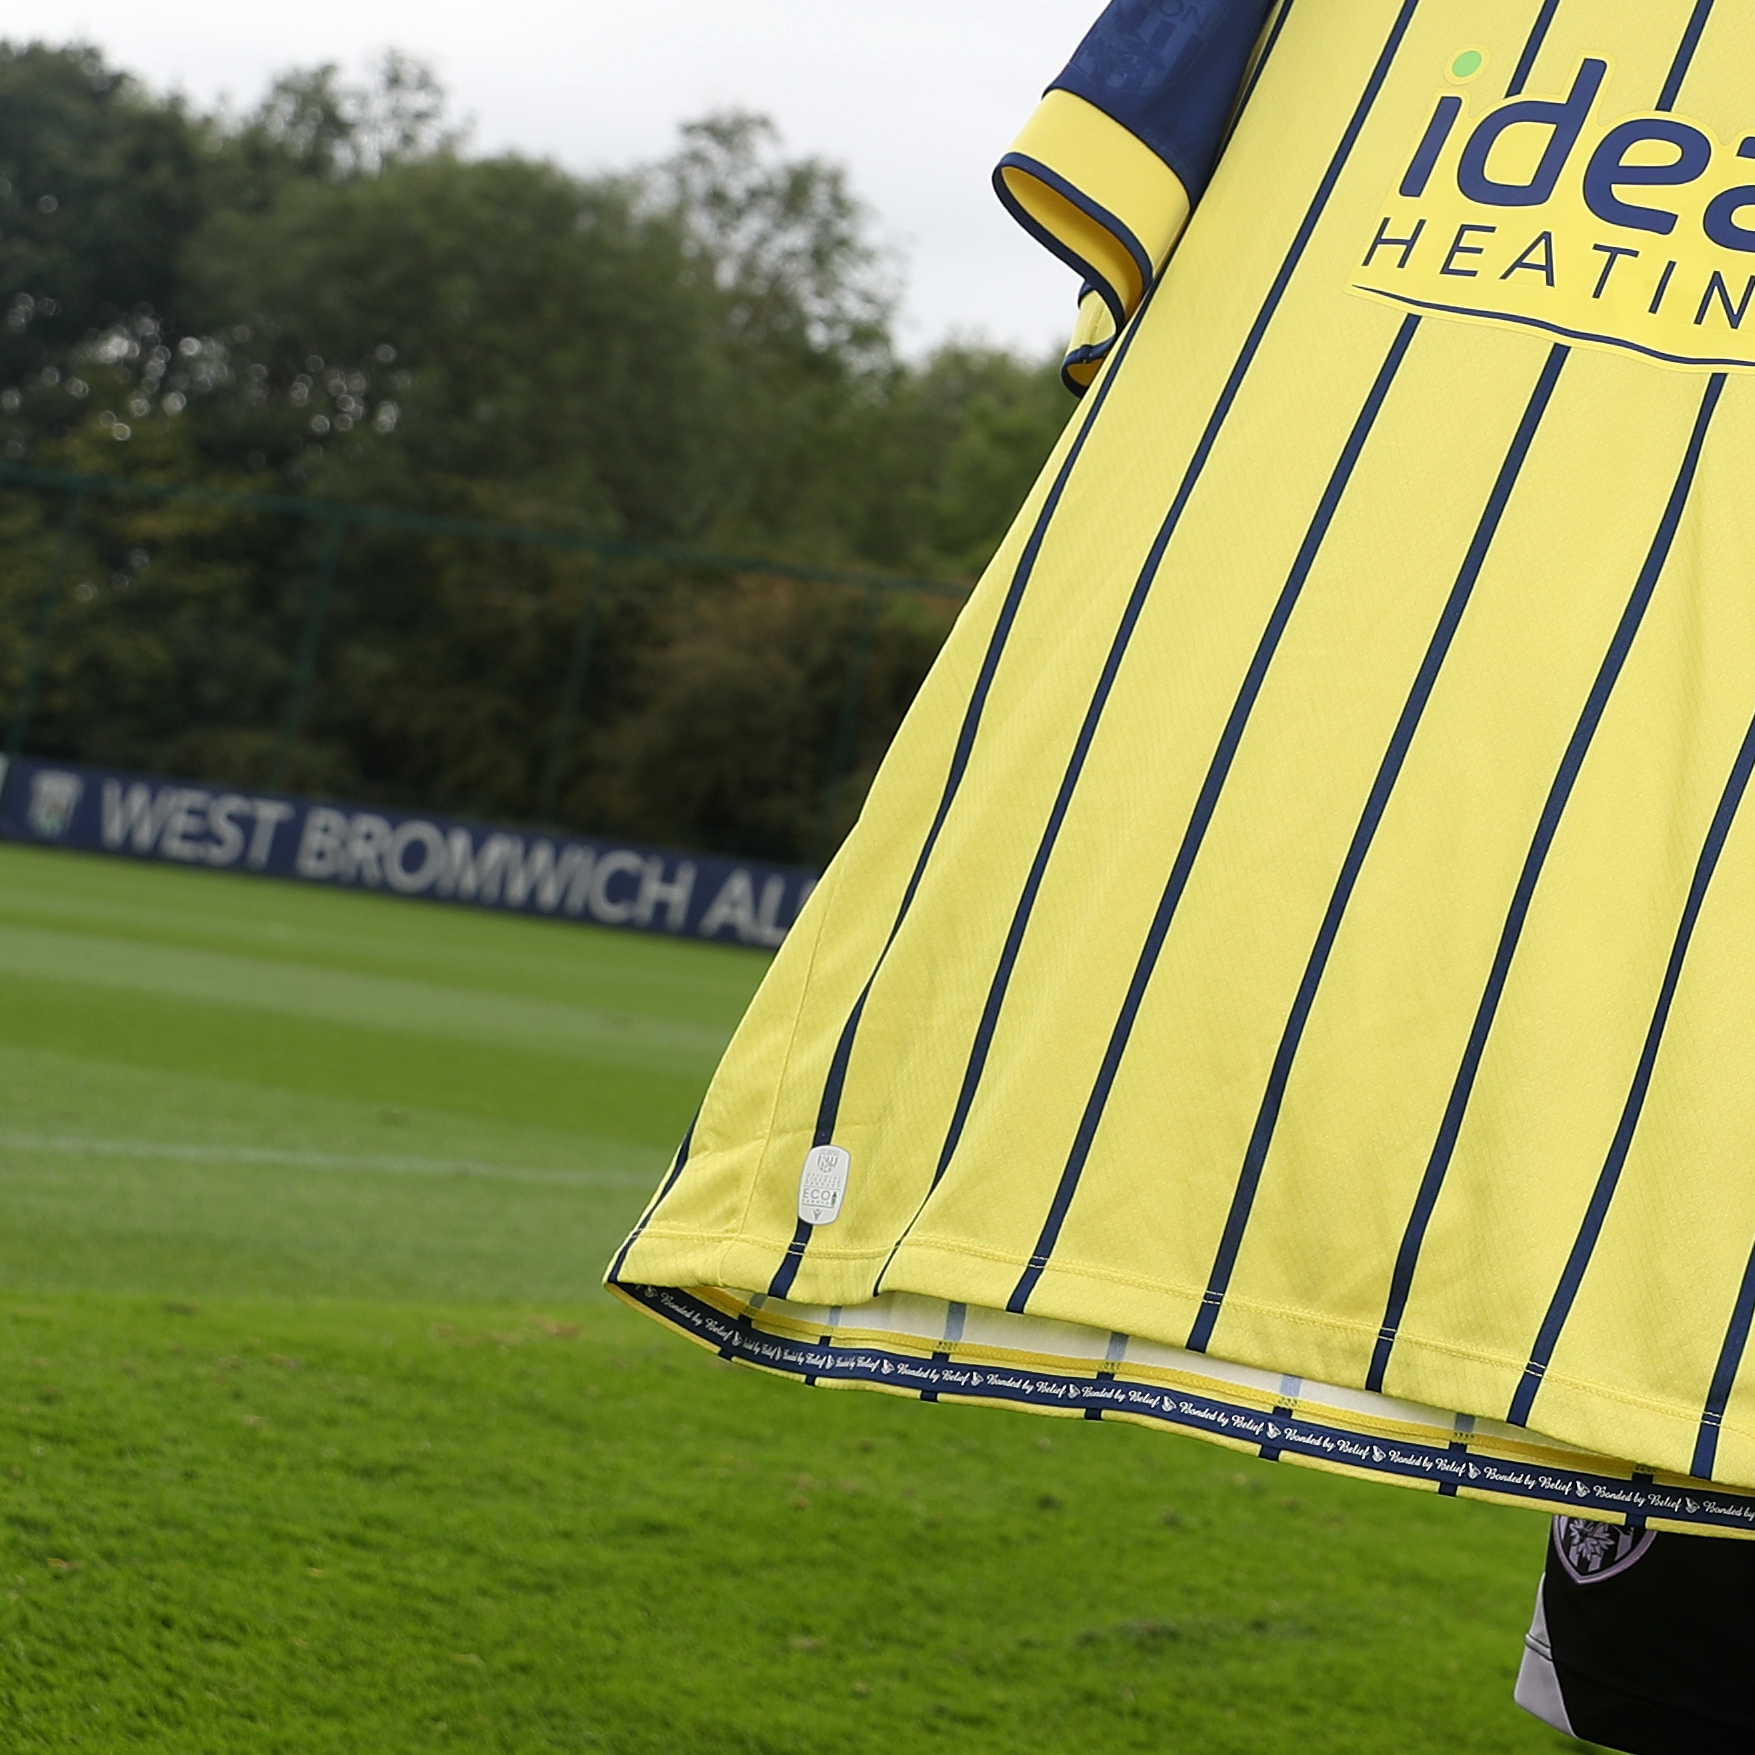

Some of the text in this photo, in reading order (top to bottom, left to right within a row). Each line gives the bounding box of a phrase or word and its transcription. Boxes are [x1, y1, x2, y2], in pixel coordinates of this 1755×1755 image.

[102, 777, 296, 870] WEST
[296, 805, 697, 931] BROMWICH
[803, 1188, 831, 1201] ECO
[691, 1313, 703, 1327] by
[897, 1363, 971, 1386] Bonded by Belief
[987, 1373, 1068, 1398] Bonded by Belief
[1082, 1386, 1161, 1408] Bonded by Belief
[1179, 1401, 1265, 1435] Bonded by Belief
[1284, 1427, 1370, 1459] Bonded by Belief
[1388, 1450, 1467, 1477] Bonded by Belief
[1484, 1466, 1574, 1495] Bonded by Belief
[1593, 1485, 1682, 1512] Bonded by Belief
[1703, 1500, 1742, 1517] Bonded
[1743, 1507, 1755, 1521] by
